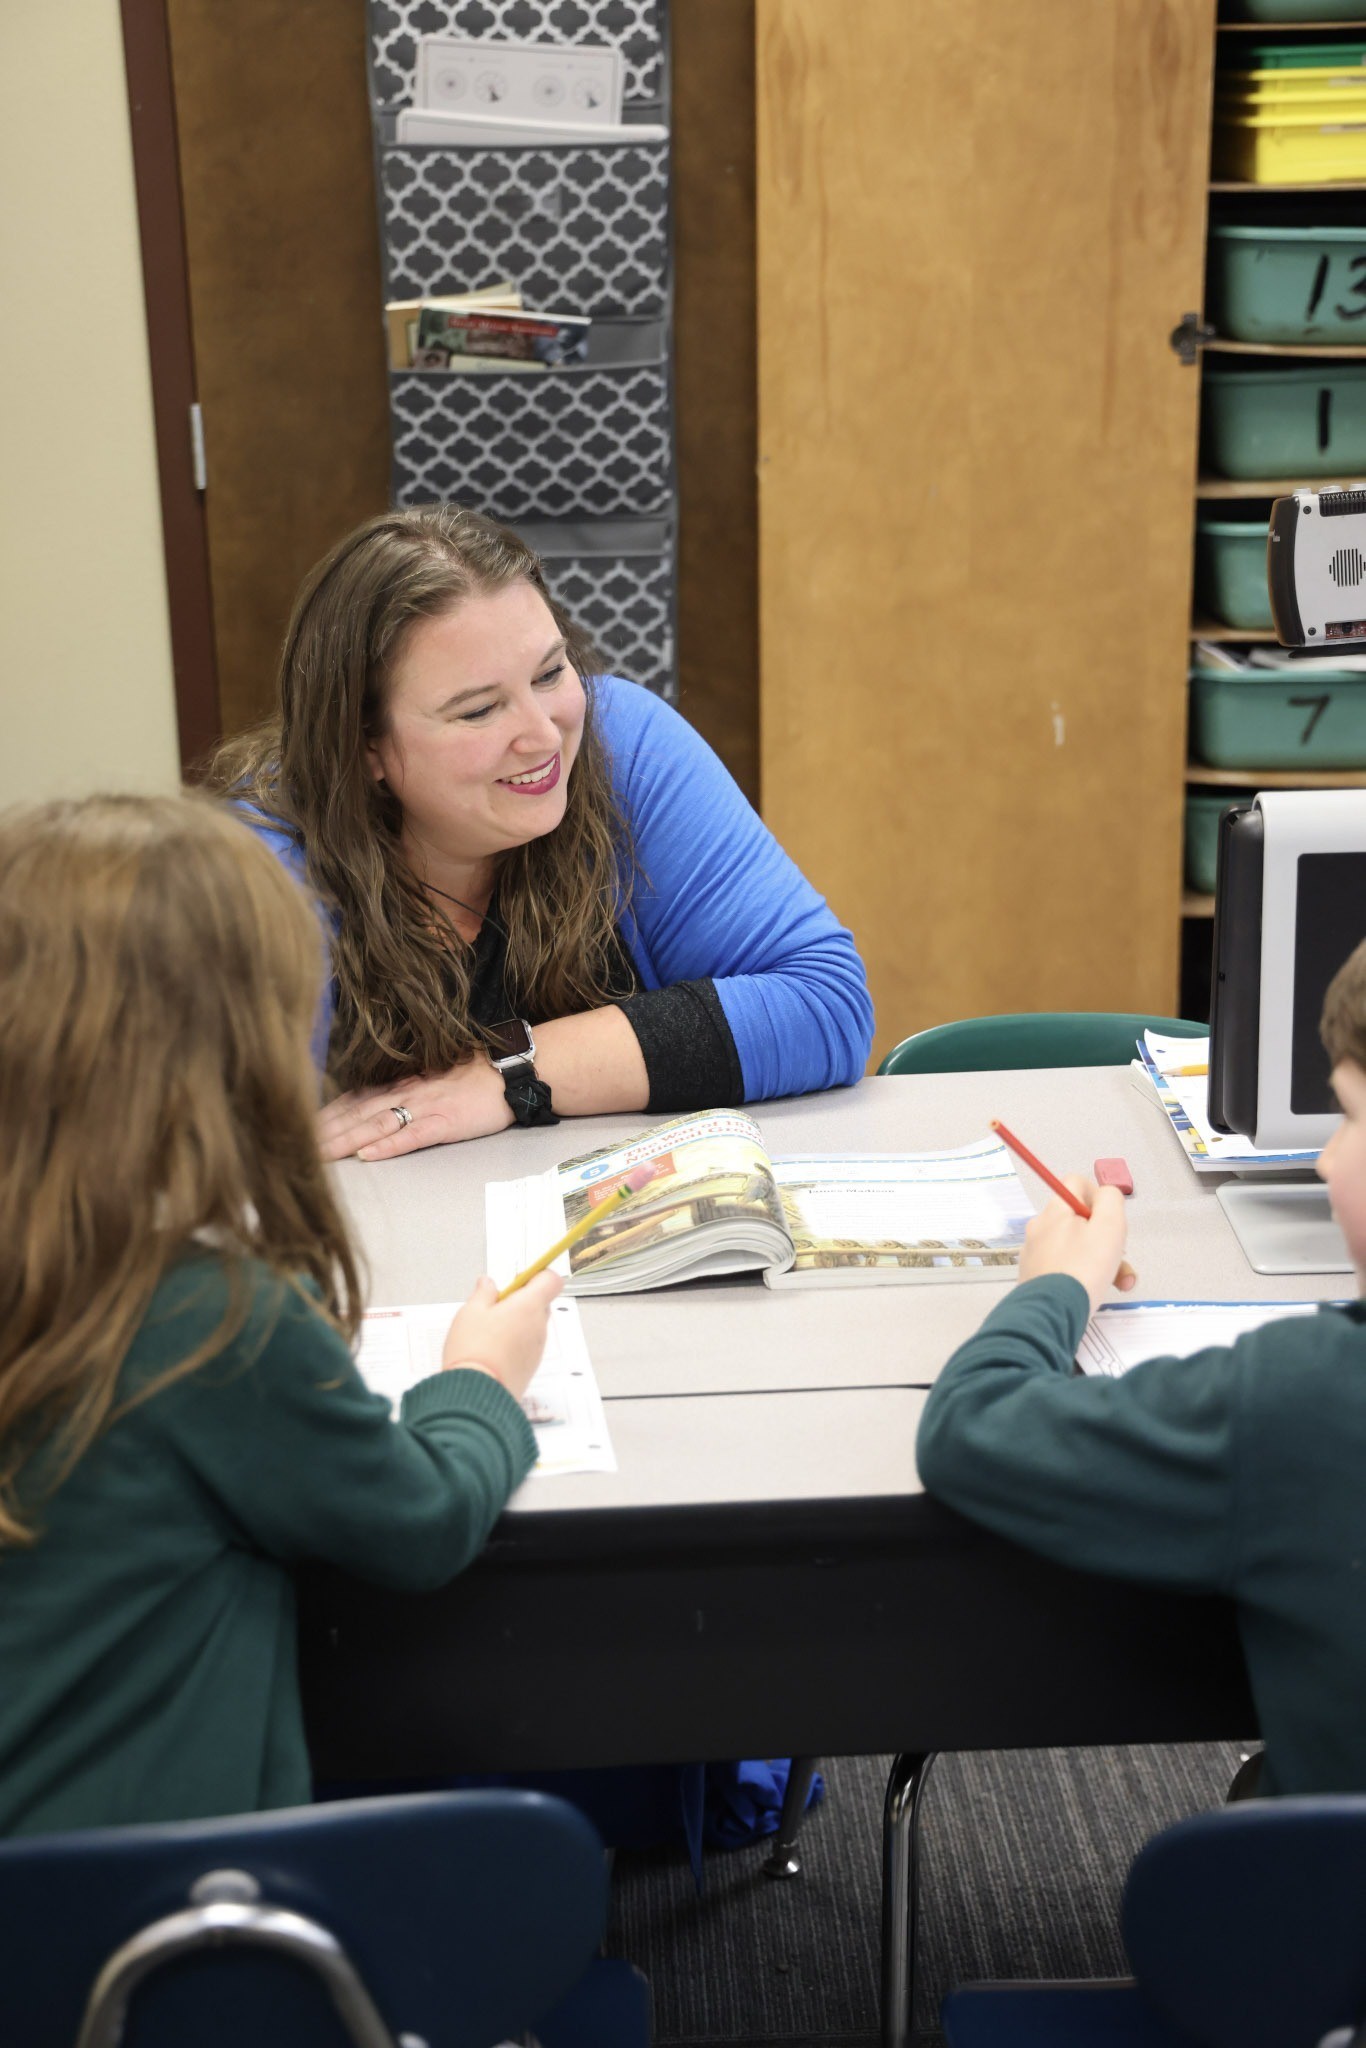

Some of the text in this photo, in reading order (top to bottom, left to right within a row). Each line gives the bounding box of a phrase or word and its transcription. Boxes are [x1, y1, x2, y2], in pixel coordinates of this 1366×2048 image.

[1306, 254, 1366, 321] 13
[1286, 694, 1330, 745] 7
[623, 1142, 658, 1158] The
[661, 1127, 695, 1142] War
[625, 1129, 702, 1165] National
